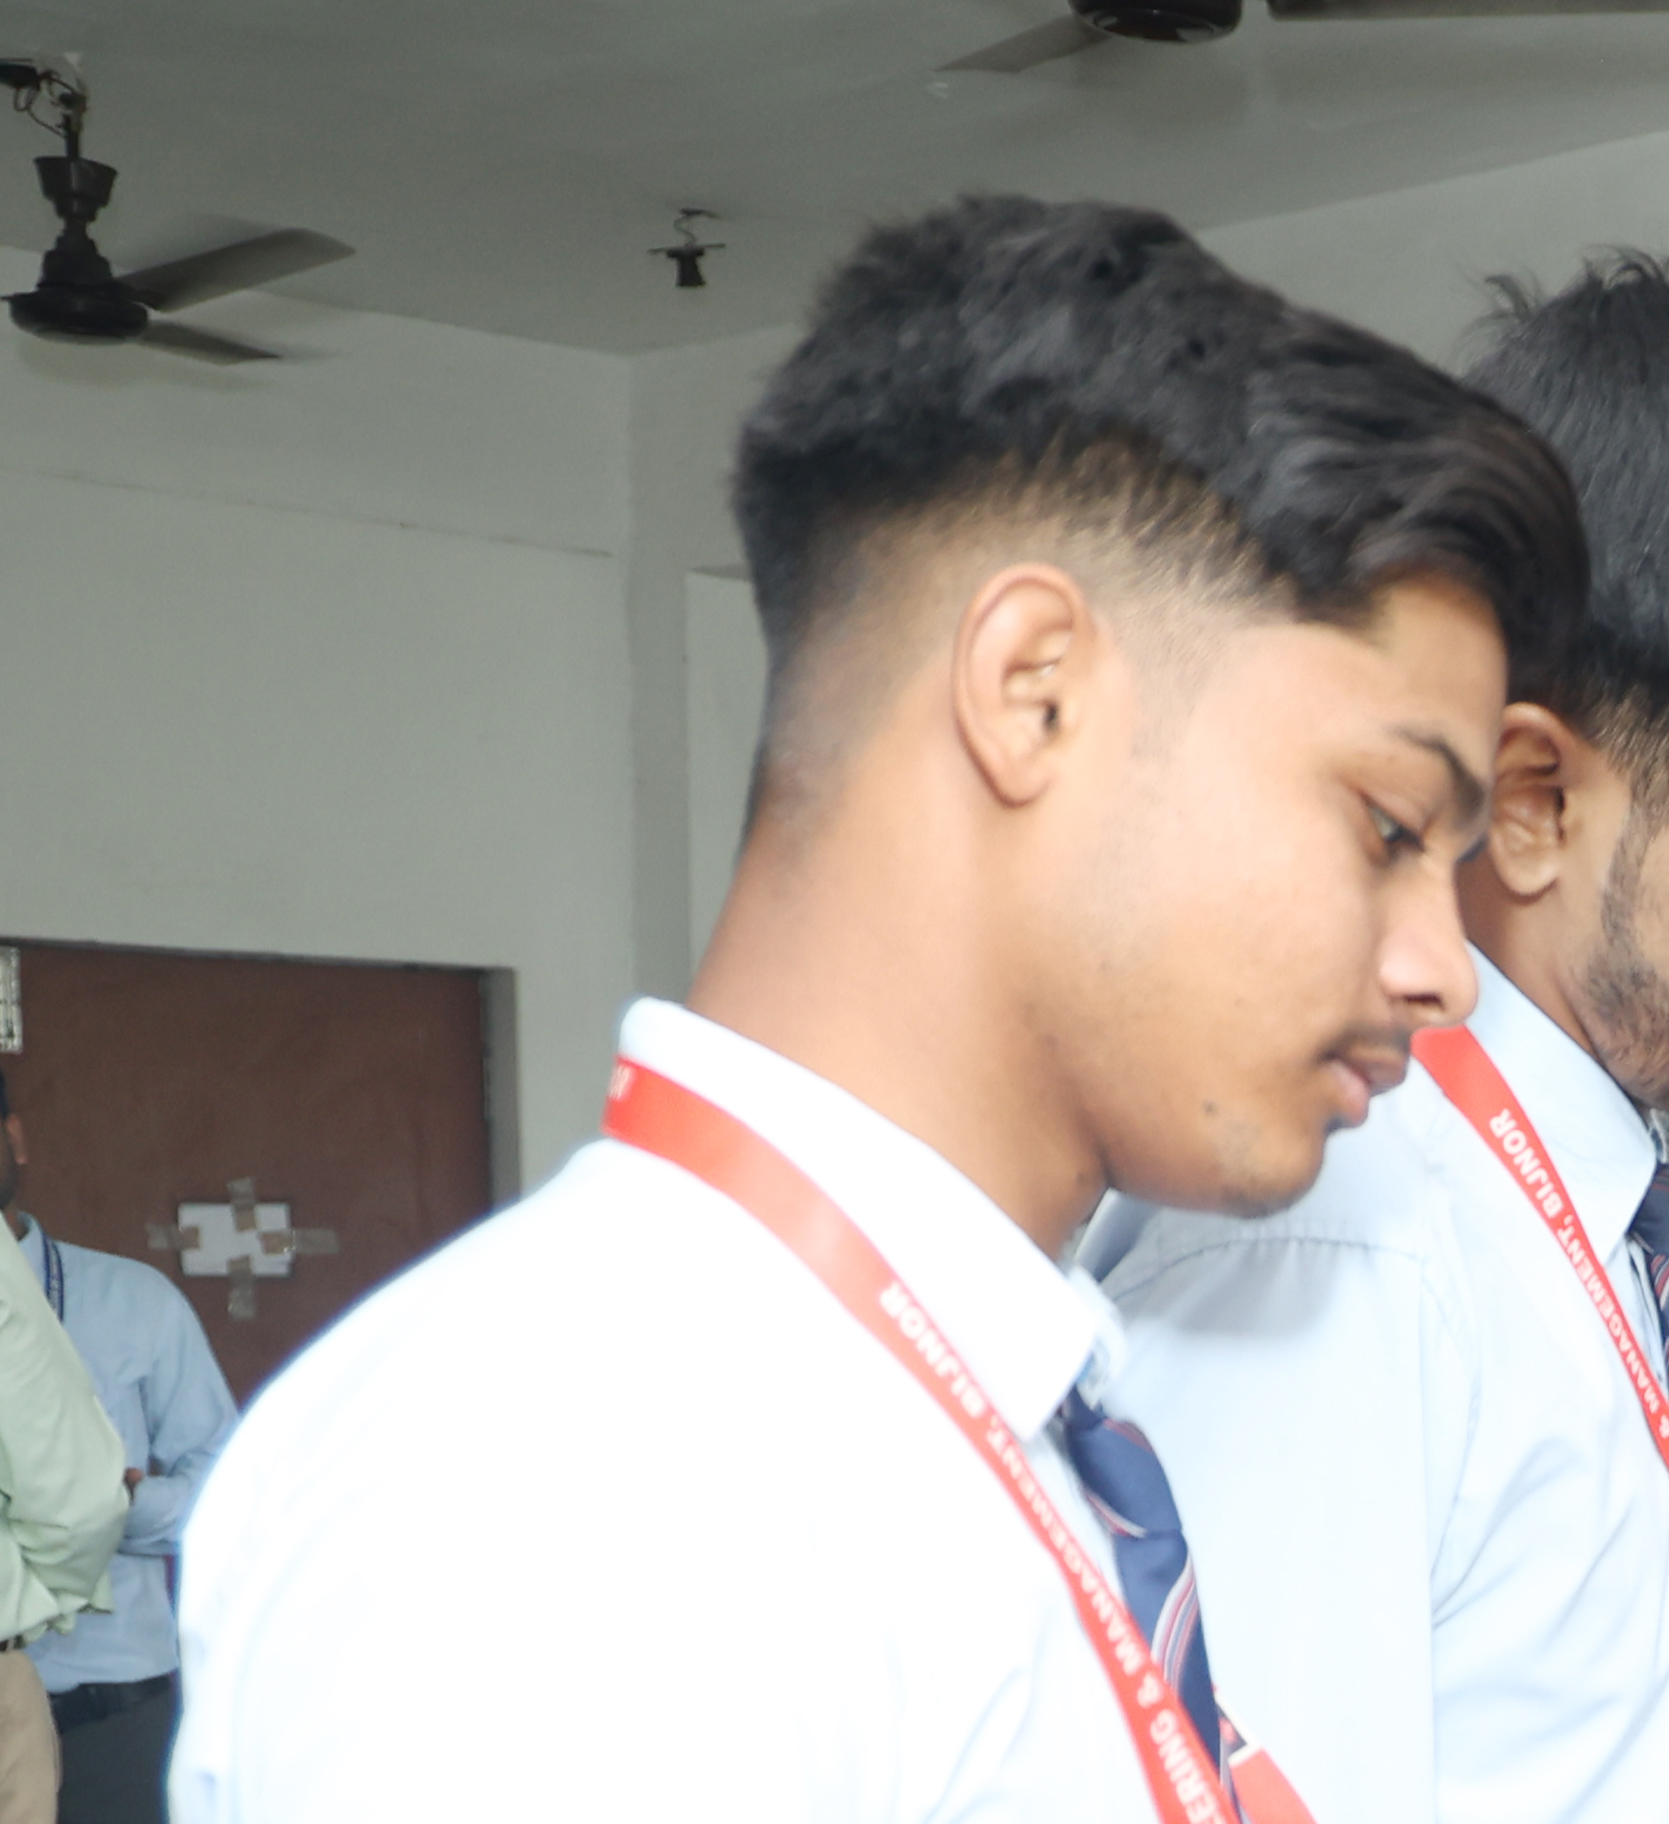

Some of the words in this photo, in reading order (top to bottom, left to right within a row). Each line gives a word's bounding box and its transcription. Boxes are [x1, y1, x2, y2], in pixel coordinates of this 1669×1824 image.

[1489, 1108, 1564, 1219] BIJNOR
[879, 1280, 986, 1418] BIJNOR
[1136, 1671, 1163, 1709] &
